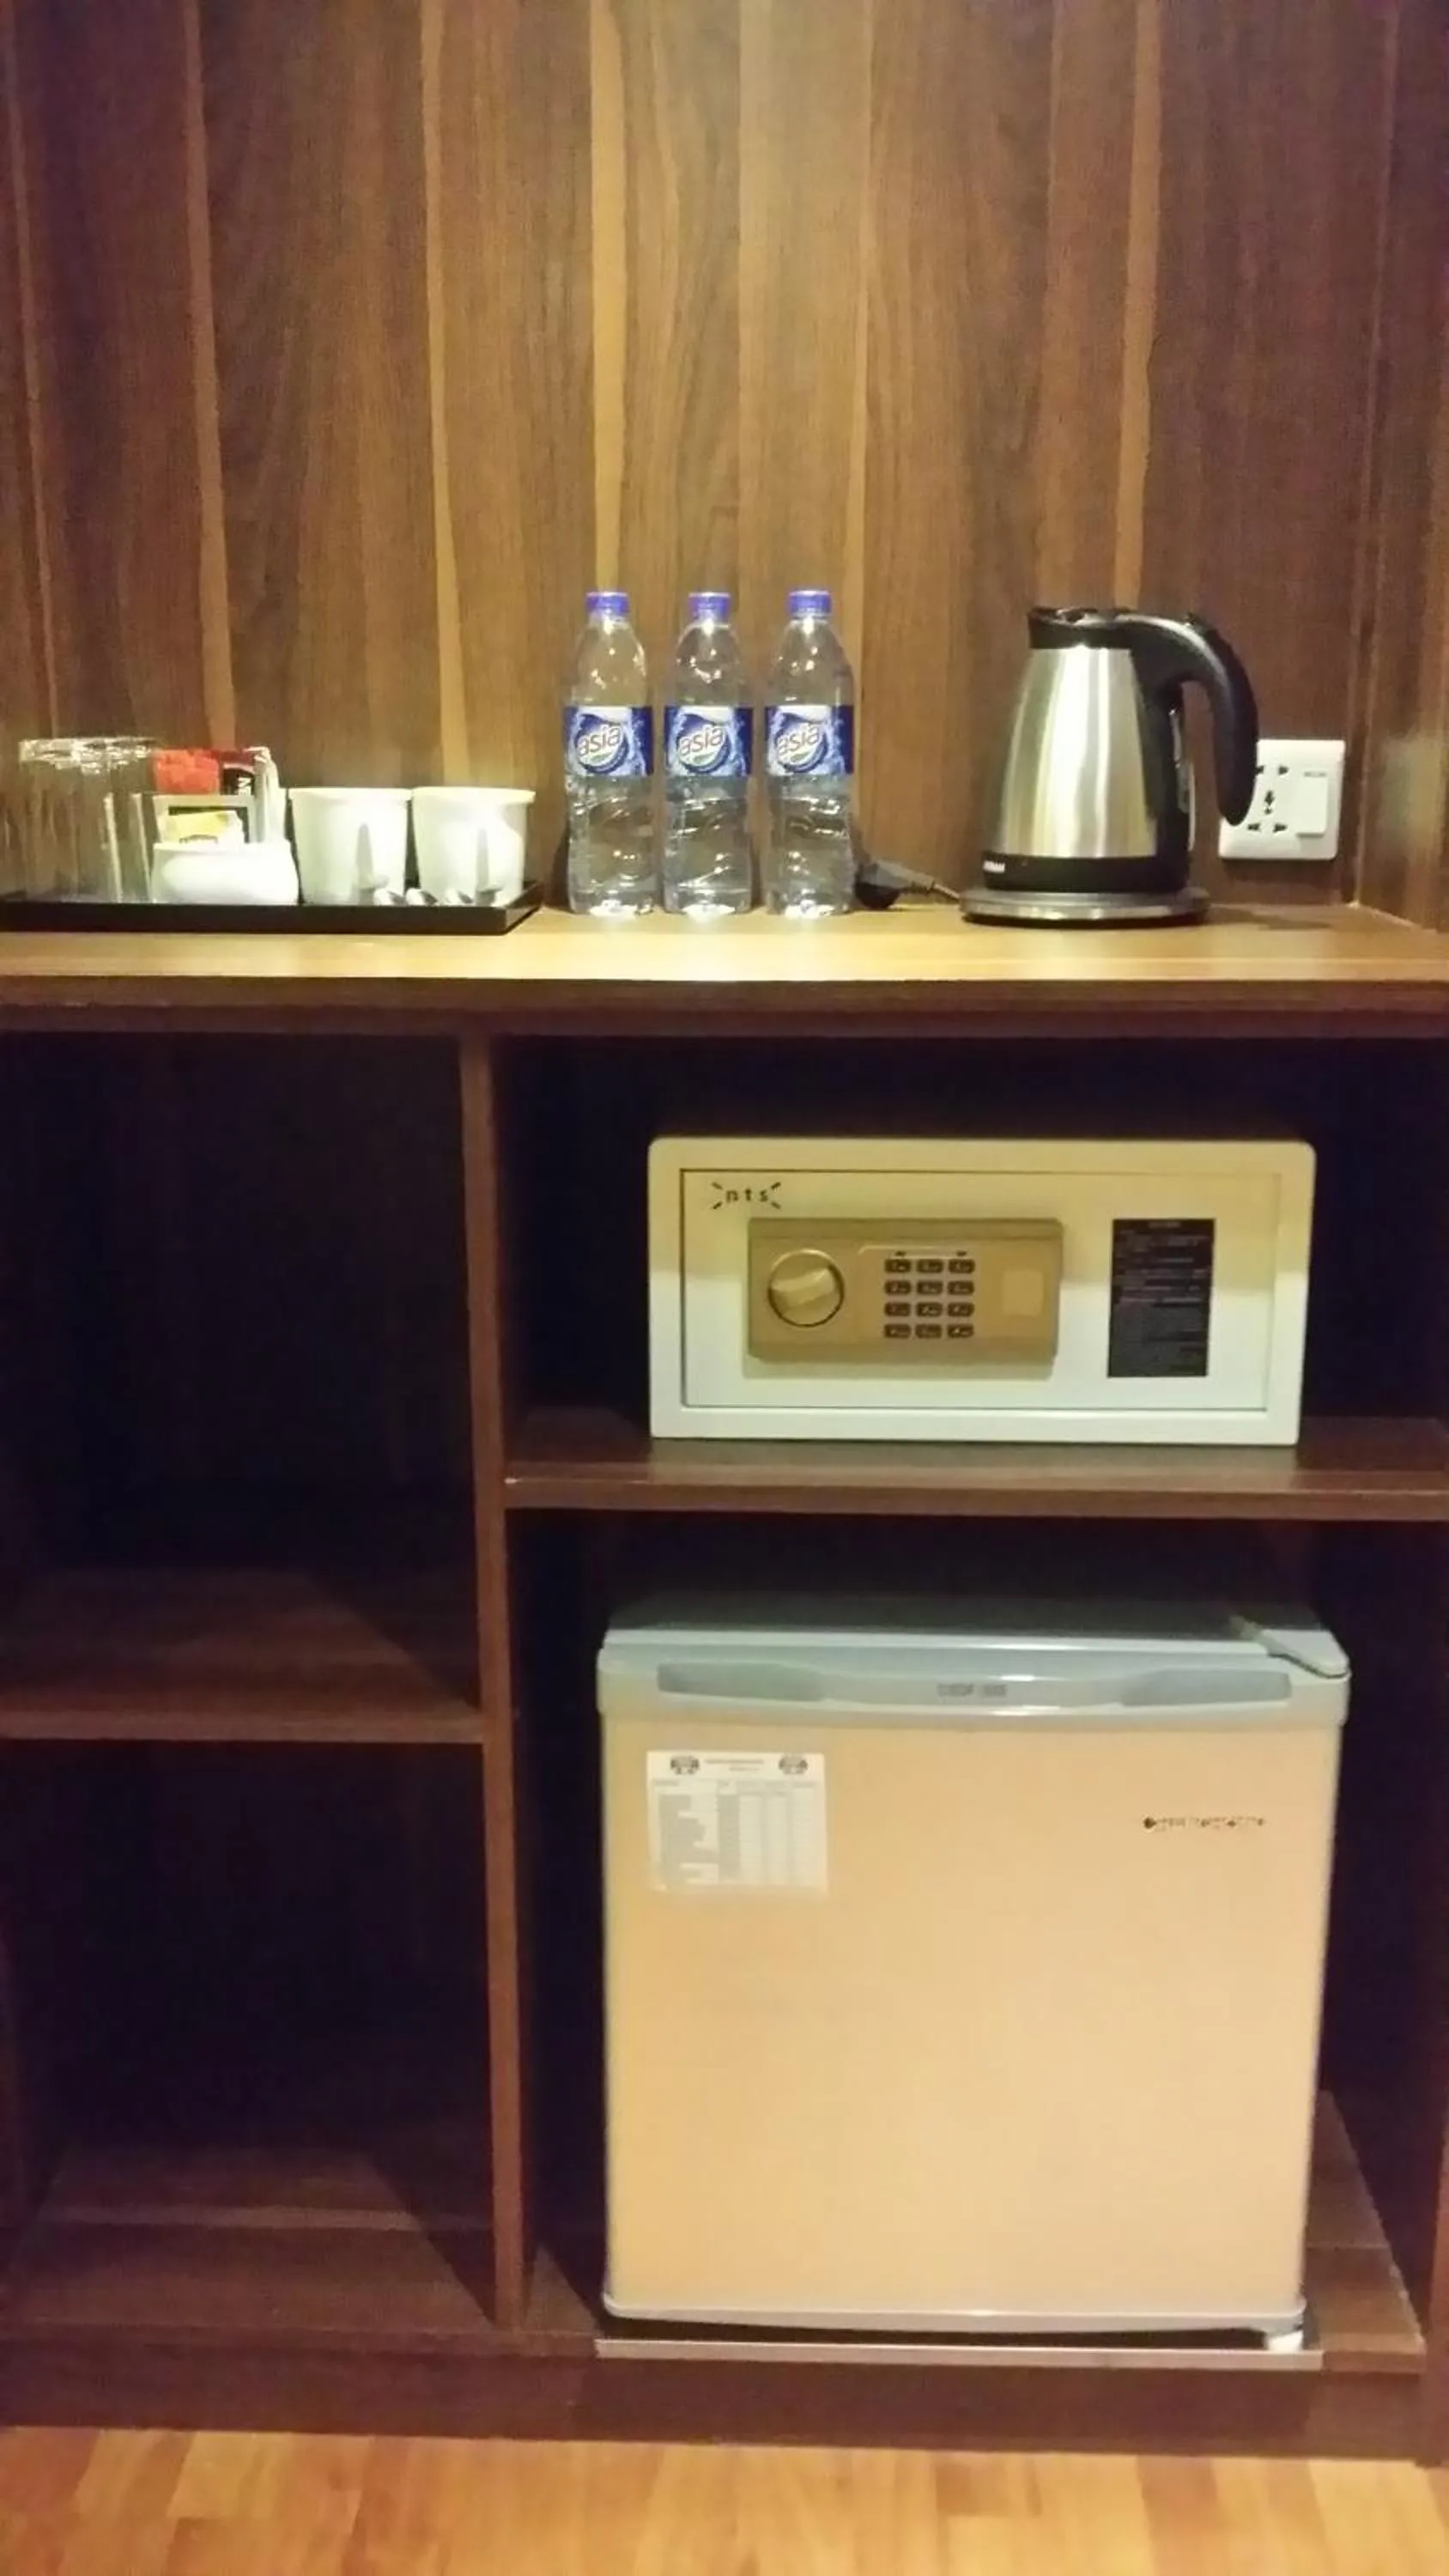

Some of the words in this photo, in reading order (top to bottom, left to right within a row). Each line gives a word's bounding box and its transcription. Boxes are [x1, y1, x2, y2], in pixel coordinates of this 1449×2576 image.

[578, 725, 622, 756] asia
[679, 725, 724, 756] asia
[778, 723, 822, 755] asia
